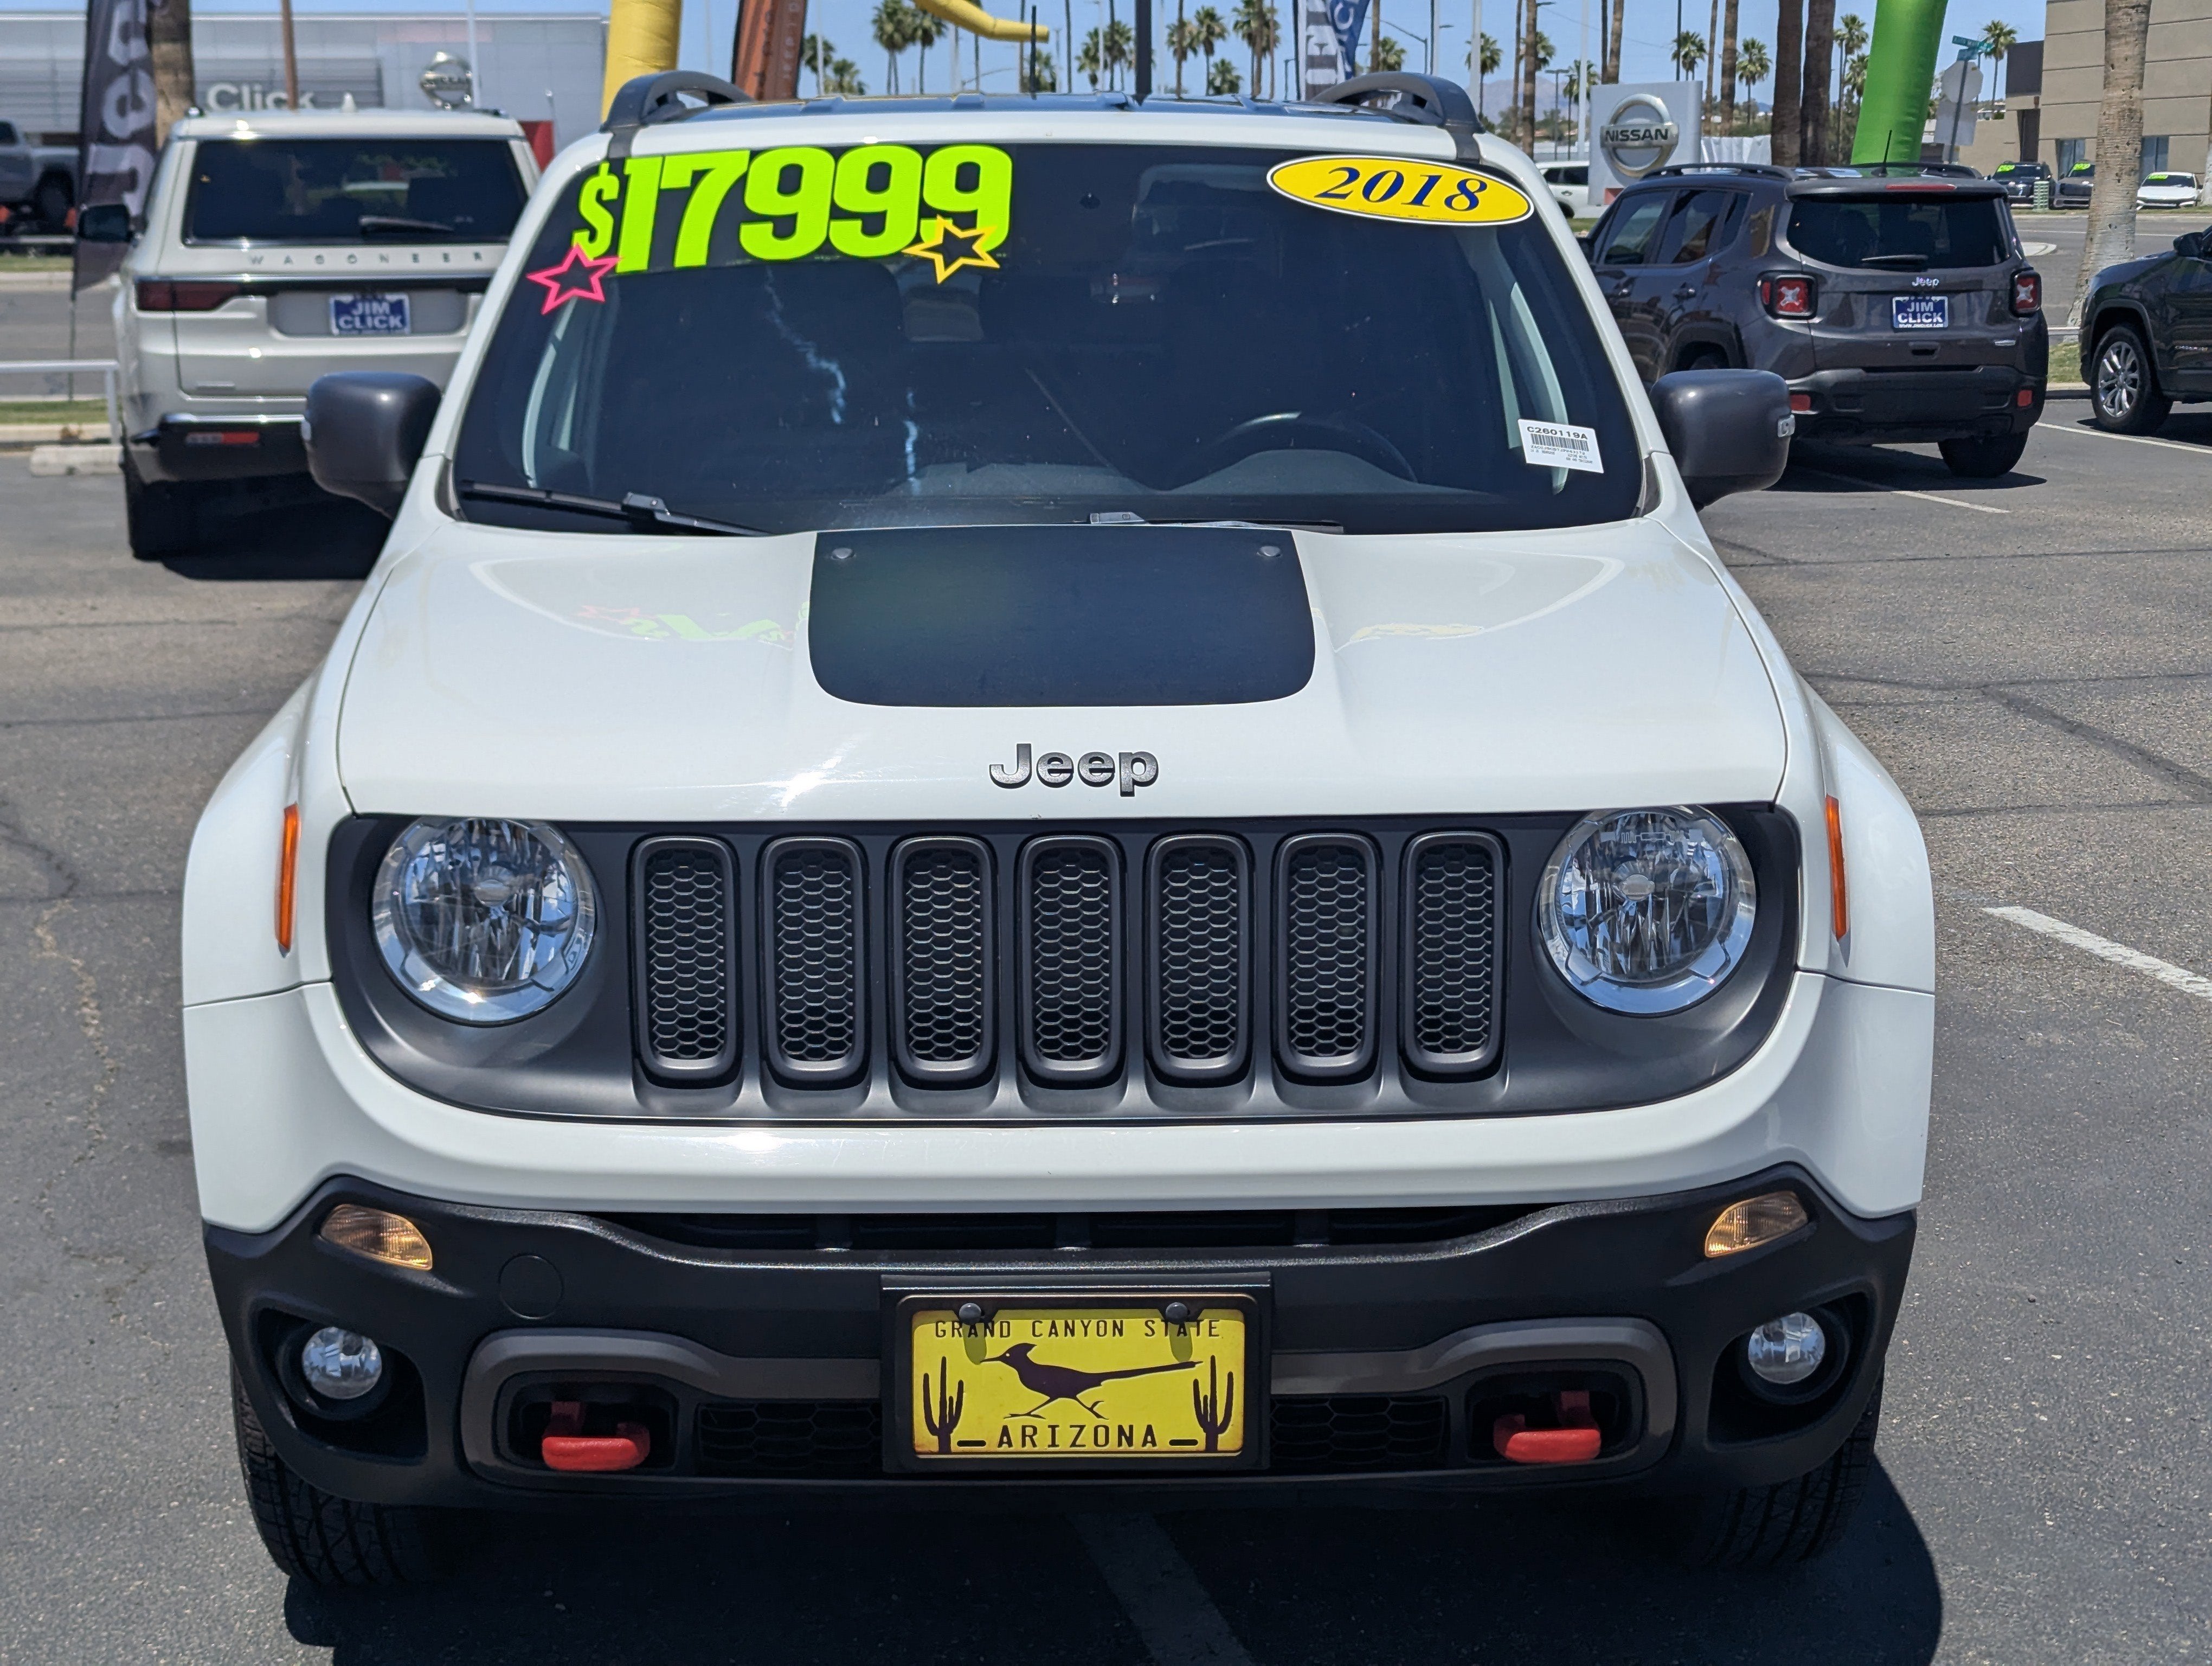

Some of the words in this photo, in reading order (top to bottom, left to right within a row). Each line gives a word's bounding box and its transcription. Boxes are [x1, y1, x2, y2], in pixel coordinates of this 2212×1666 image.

[1605, 129, 1668, 142] NISSAN
[1314, 166, 1488, 212] 2018
[573, 145, 1012, 273] $17999
[249, 251, 482, 265] WAGONEER
[1912, 277, 1940, 288] Jeep
[352, 301, 390, 315] JIM
[1907, 302, 1933, 312] JIM
[338, 314, 403, 329] CLICK
[1898, 312, 1943, 323] CLICK
[1527, 426, 1588, 440] C260119A
[989, 743, 1159, 797] Jeep
[935, 1319, 1011, 1339] GRAND
[1031, 1319, 1124, 1338] CANYON
[1143, 1319, 1220, 1338] STATE
[996, 1424, 1158, 1449] ARIZONA
